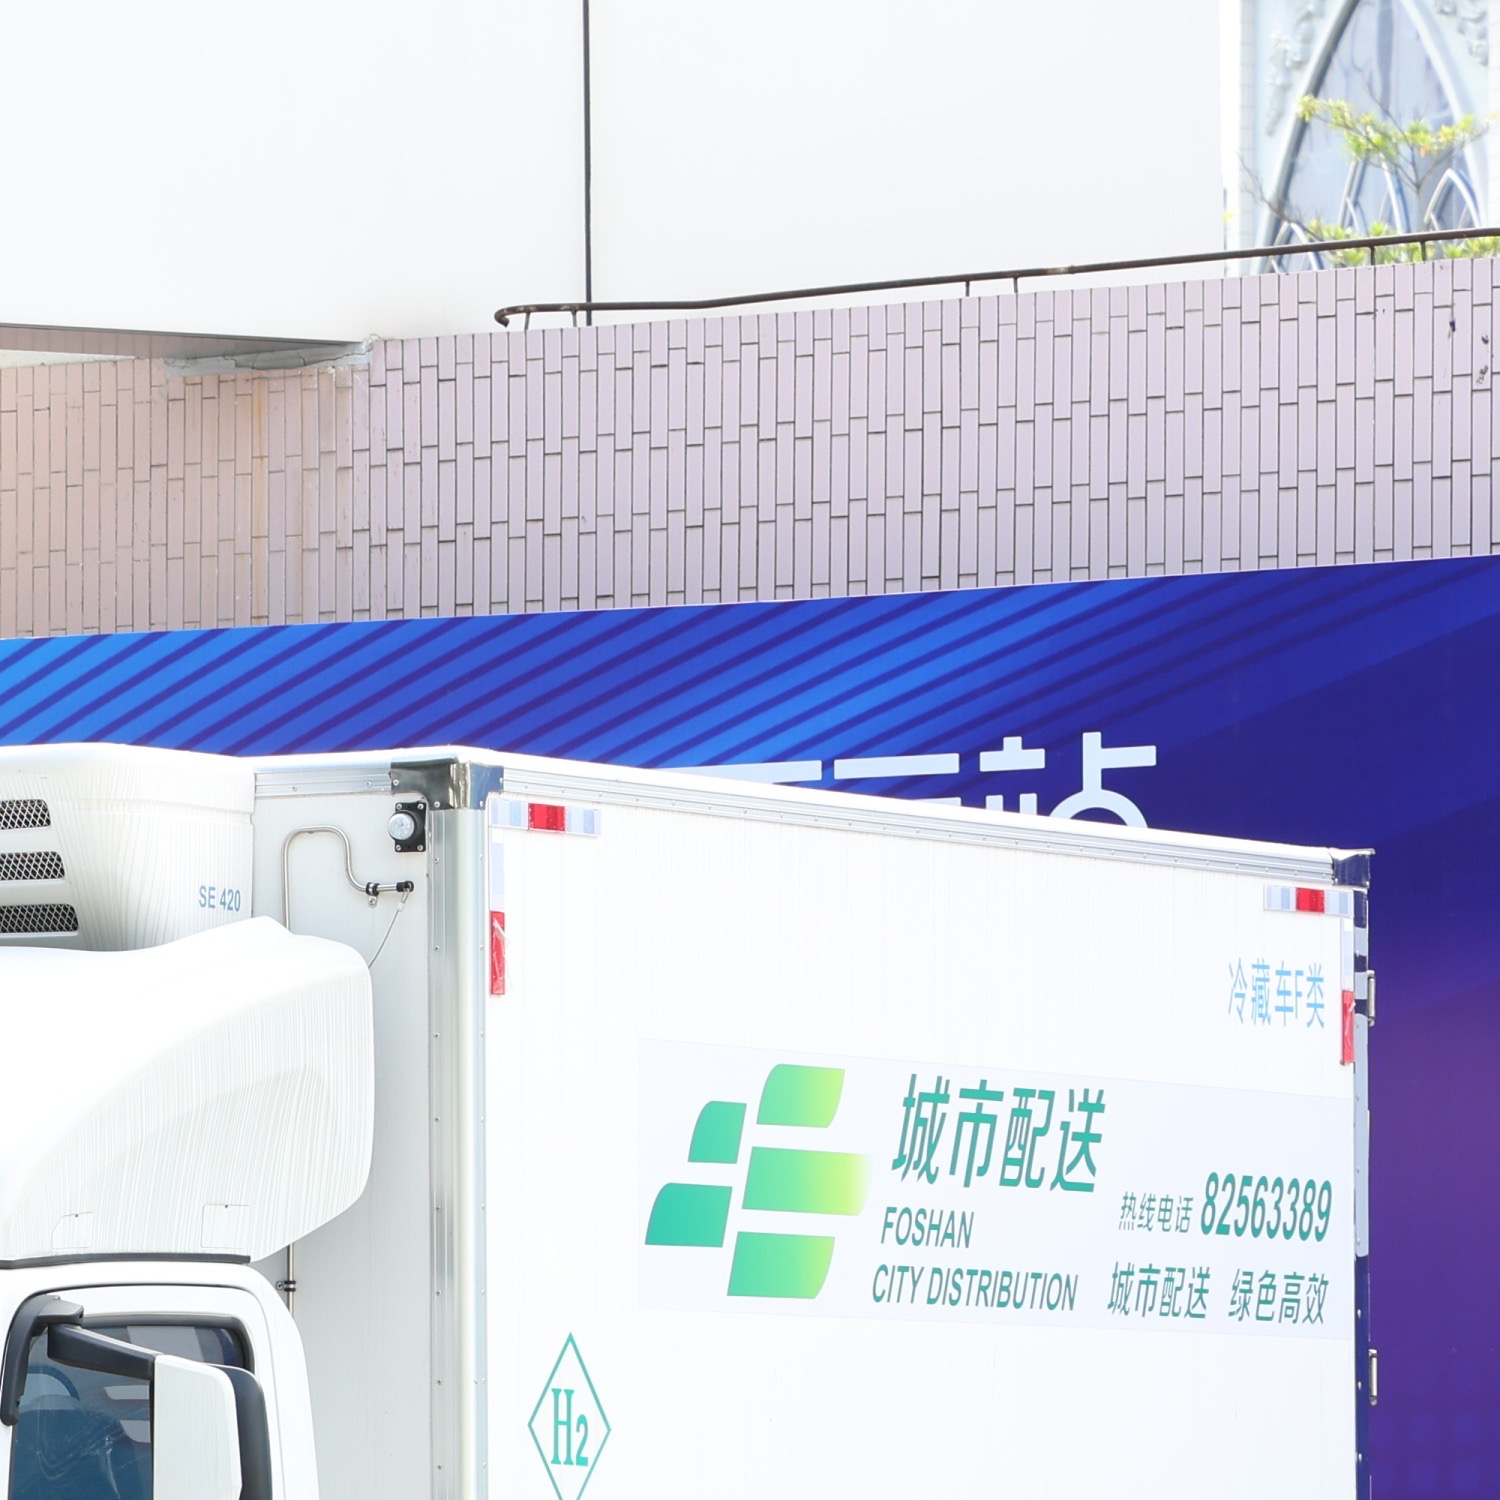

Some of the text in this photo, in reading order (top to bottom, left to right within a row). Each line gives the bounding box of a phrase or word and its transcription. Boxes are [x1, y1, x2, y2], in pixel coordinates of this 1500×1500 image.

[198, 886, 242, 912] SE 420
[1228, 957, 1326, 1030] 冷藏车F类
[891, 1073, 1106, 1193] 城市配送
[880, 1206, 976, 1249] FOSHAN
[1118, 1172, 1333, 1242] 热线电话 82563389
[872, 1264, 1079, 1311] CITY DISTRIBUTION
[1107, 1261, 1330, 1325] 城市配送 绿色高效
